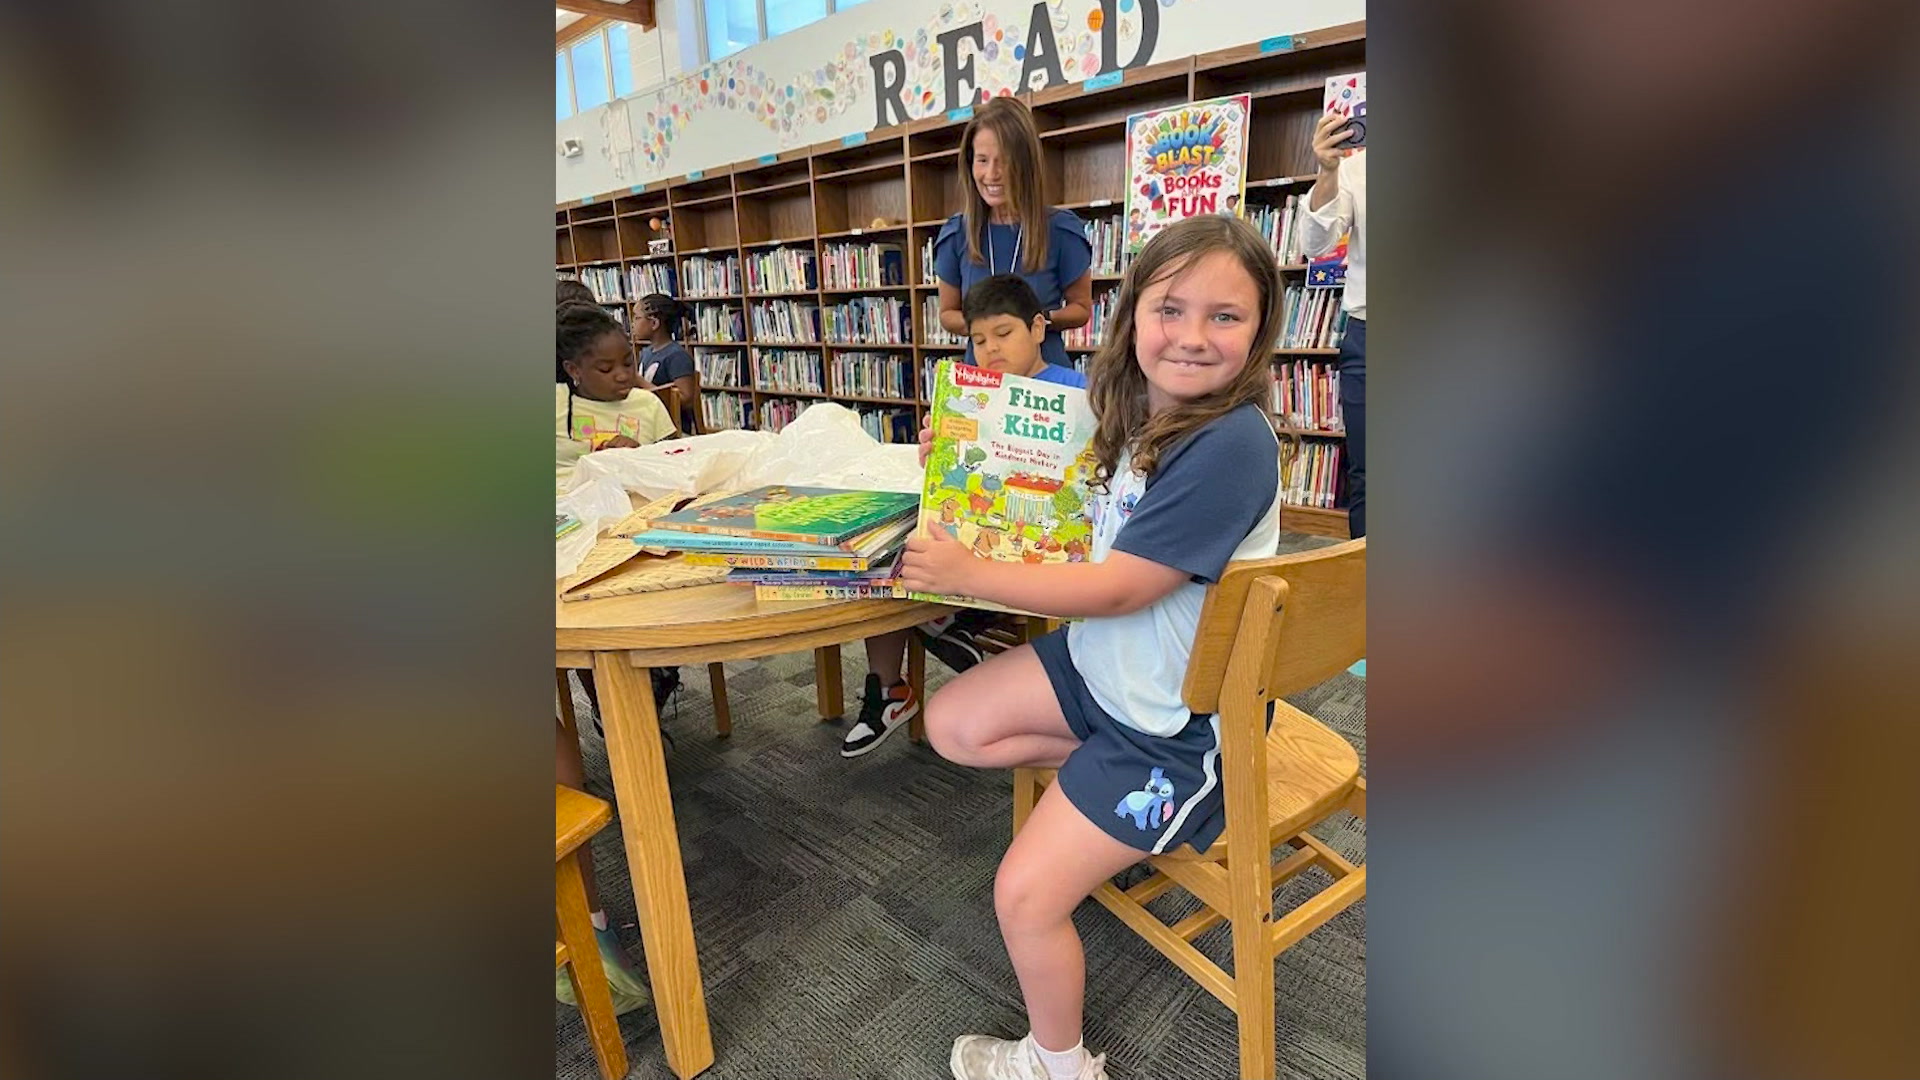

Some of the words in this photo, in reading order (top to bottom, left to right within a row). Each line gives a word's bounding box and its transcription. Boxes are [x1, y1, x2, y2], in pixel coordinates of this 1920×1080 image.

[869, 0, 1160, 129] READ
[1157, 124, 1214, 150] BOOK
[1156, 145, 1215, 171] BLAST
[1169, 192, 1217, 217] FUN
[956, 366, 1000, 386] Highlights
[1009, 386, 1066, 415] Find
[1003, 413, 1066, 443] Kind
[1033, 413, 1050, 423] the
[991, 440, 1004, 450] The
[1036, 449, 1050, 460] Day
[741, 557, 766, 566] WILD
